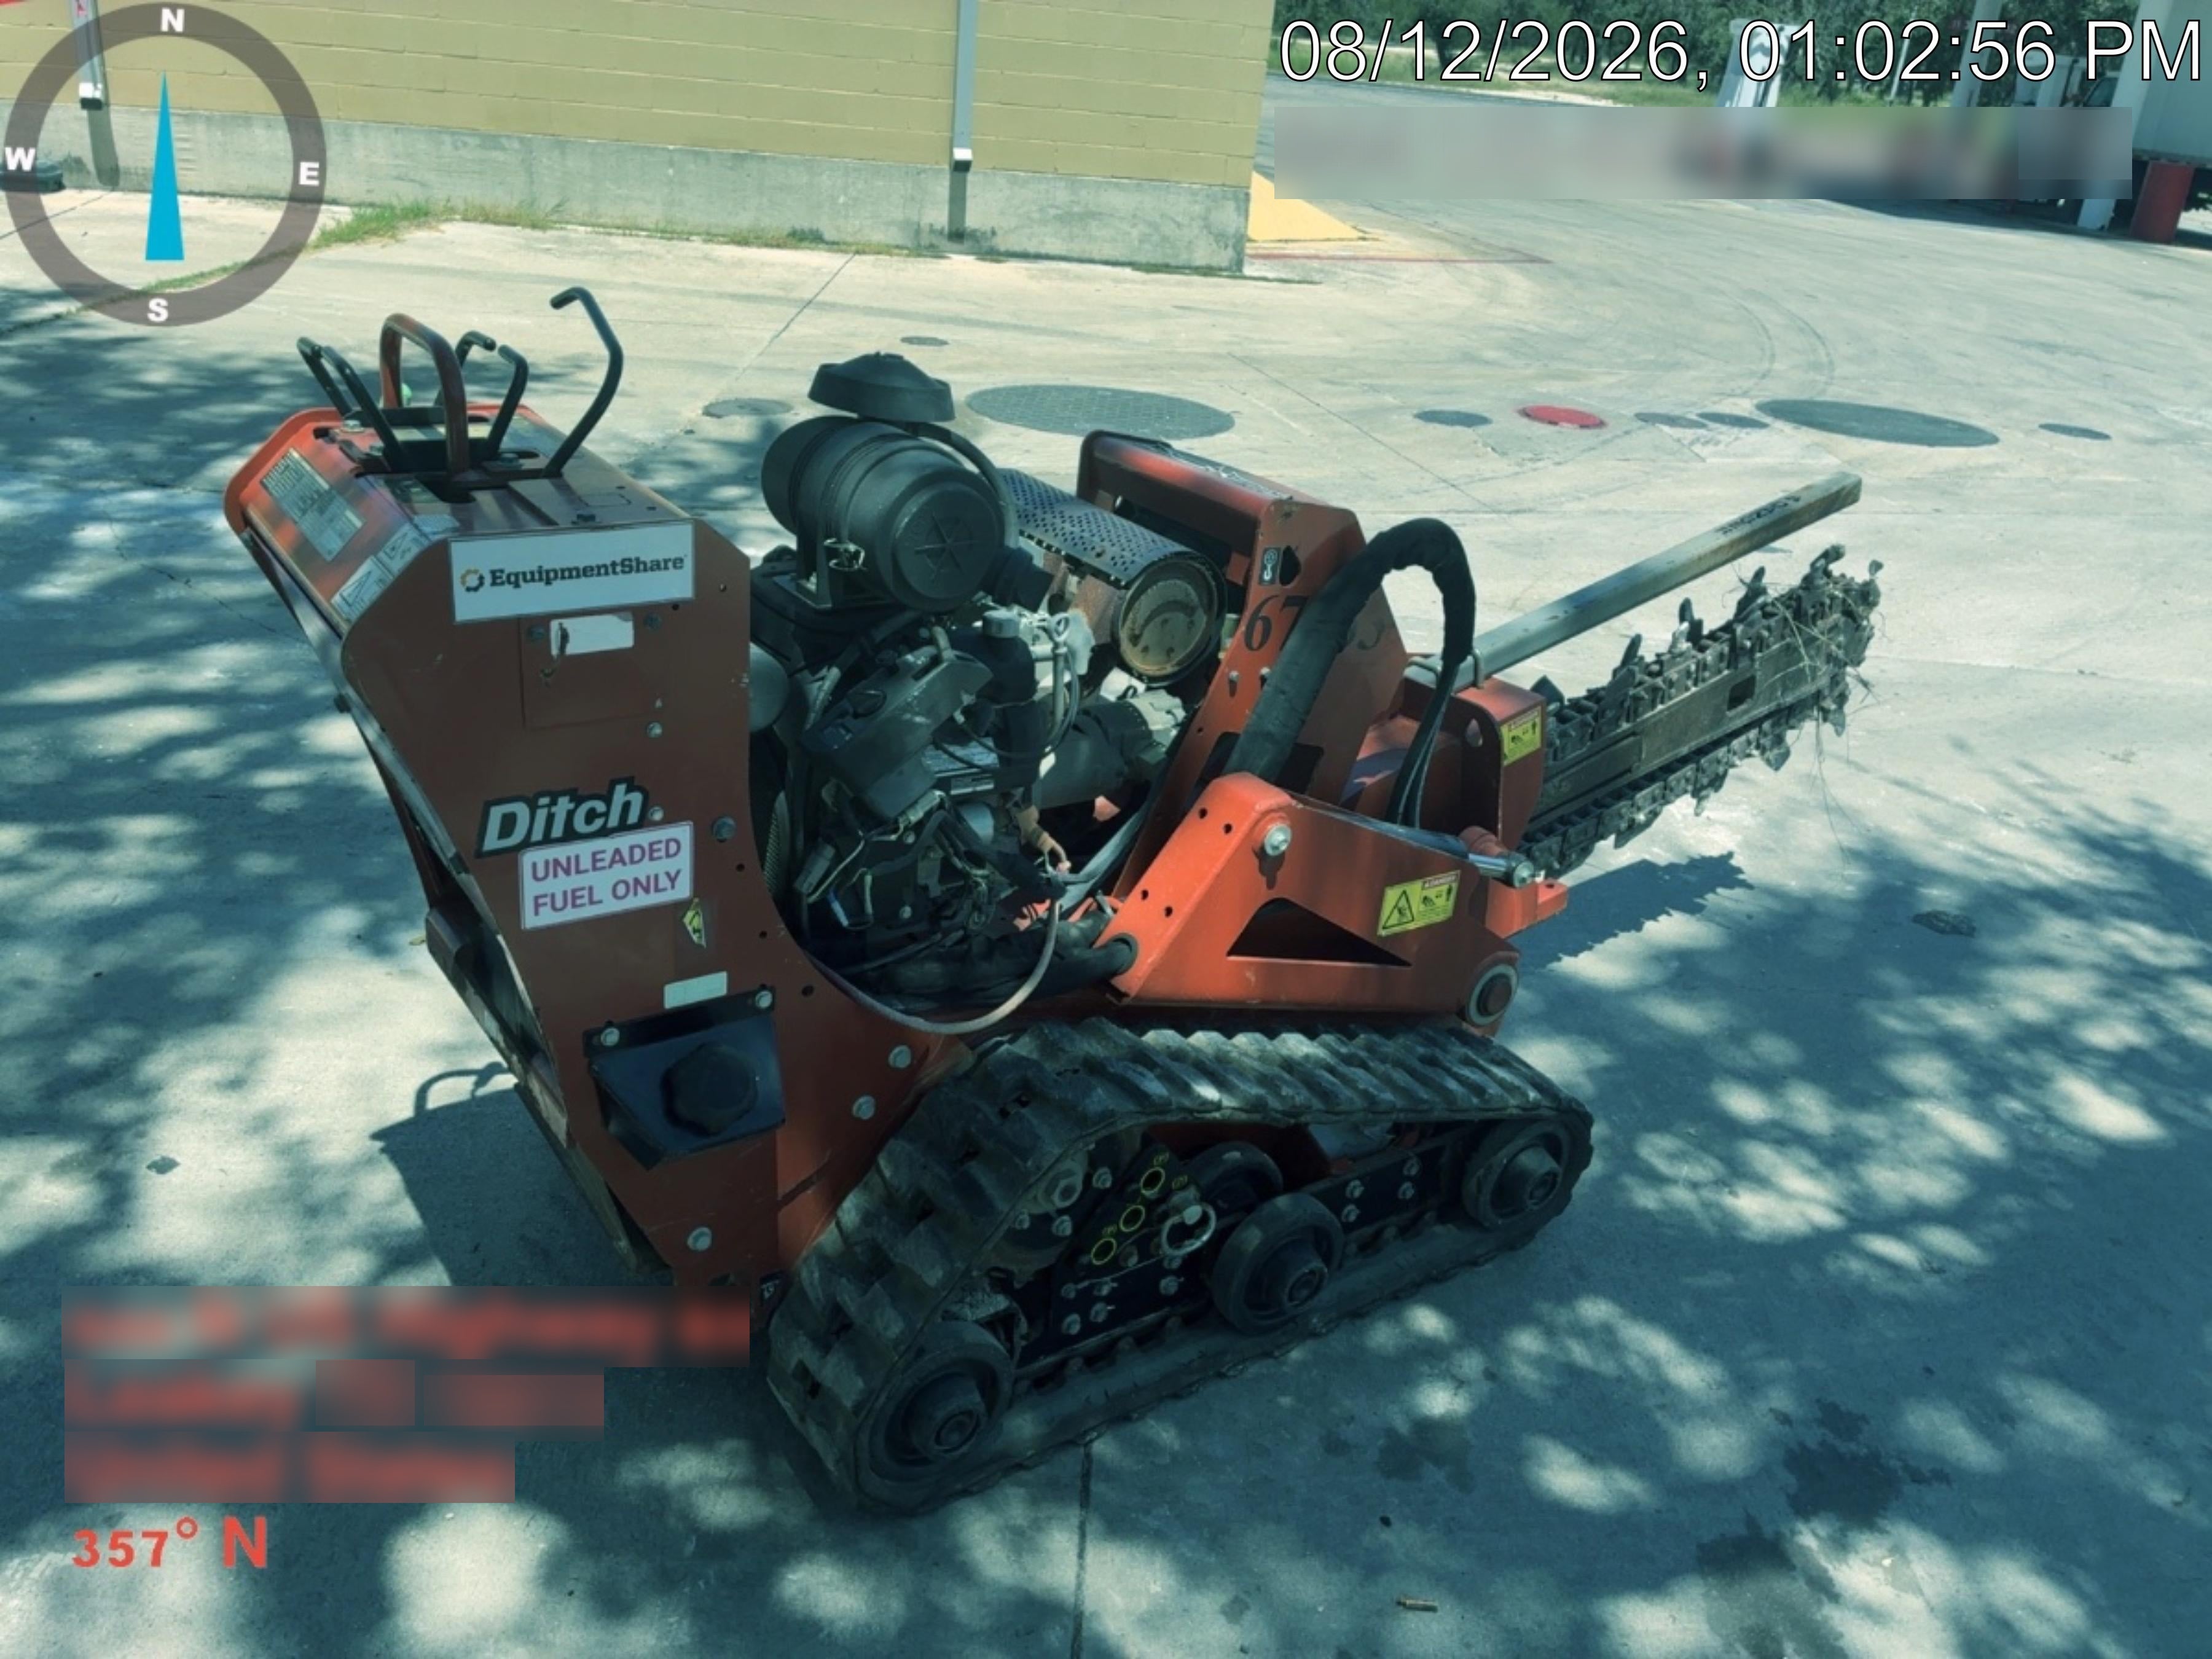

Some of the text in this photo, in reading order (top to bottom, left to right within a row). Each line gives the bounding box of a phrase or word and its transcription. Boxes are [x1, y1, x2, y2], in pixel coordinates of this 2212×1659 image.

[489, 555, 685, 589] EquipmentShare
[480, 782, 644, 854] Ditch
[531, 837, 682, 882] UNLEADED
[533, 868, 683, 917] FUEL ONLY
